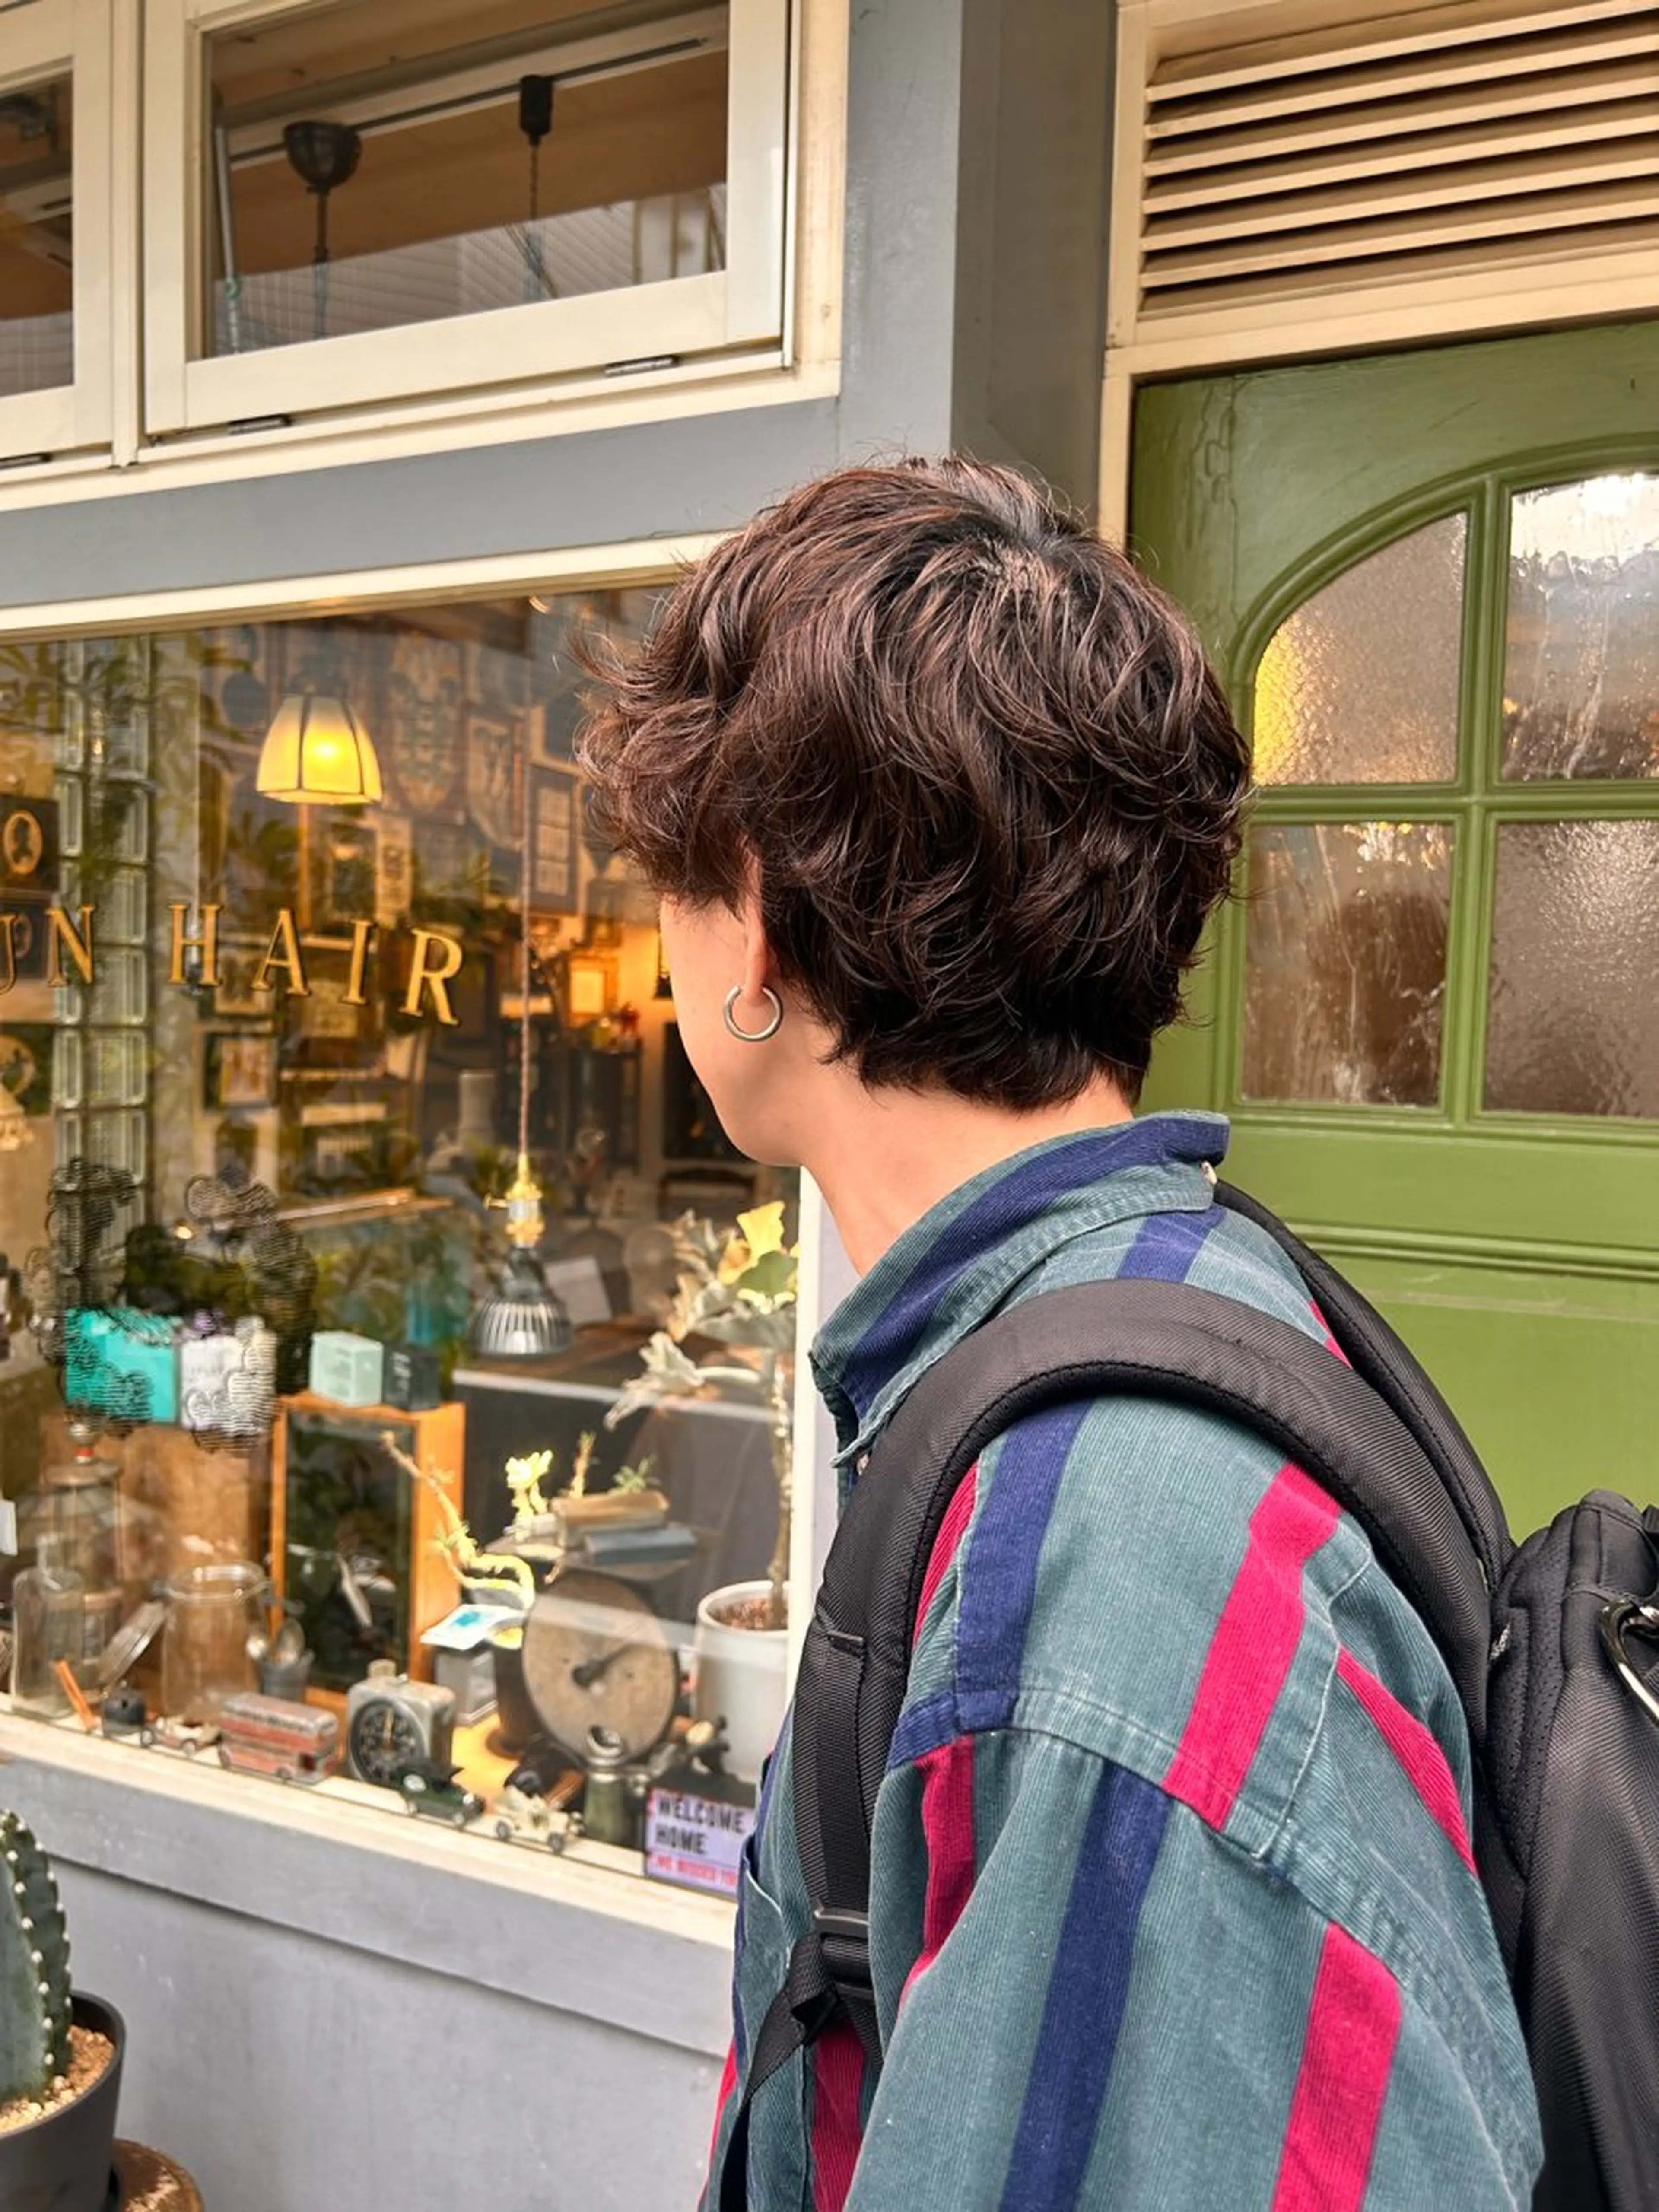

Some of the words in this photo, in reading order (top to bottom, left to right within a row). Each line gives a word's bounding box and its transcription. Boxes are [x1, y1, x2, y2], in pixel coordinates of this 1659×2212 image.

[169, 904, 463, 1025] HAIR
[659, 1796, 745, 1834] WELCOME
[655, 1823, 706, 1854] HOME
